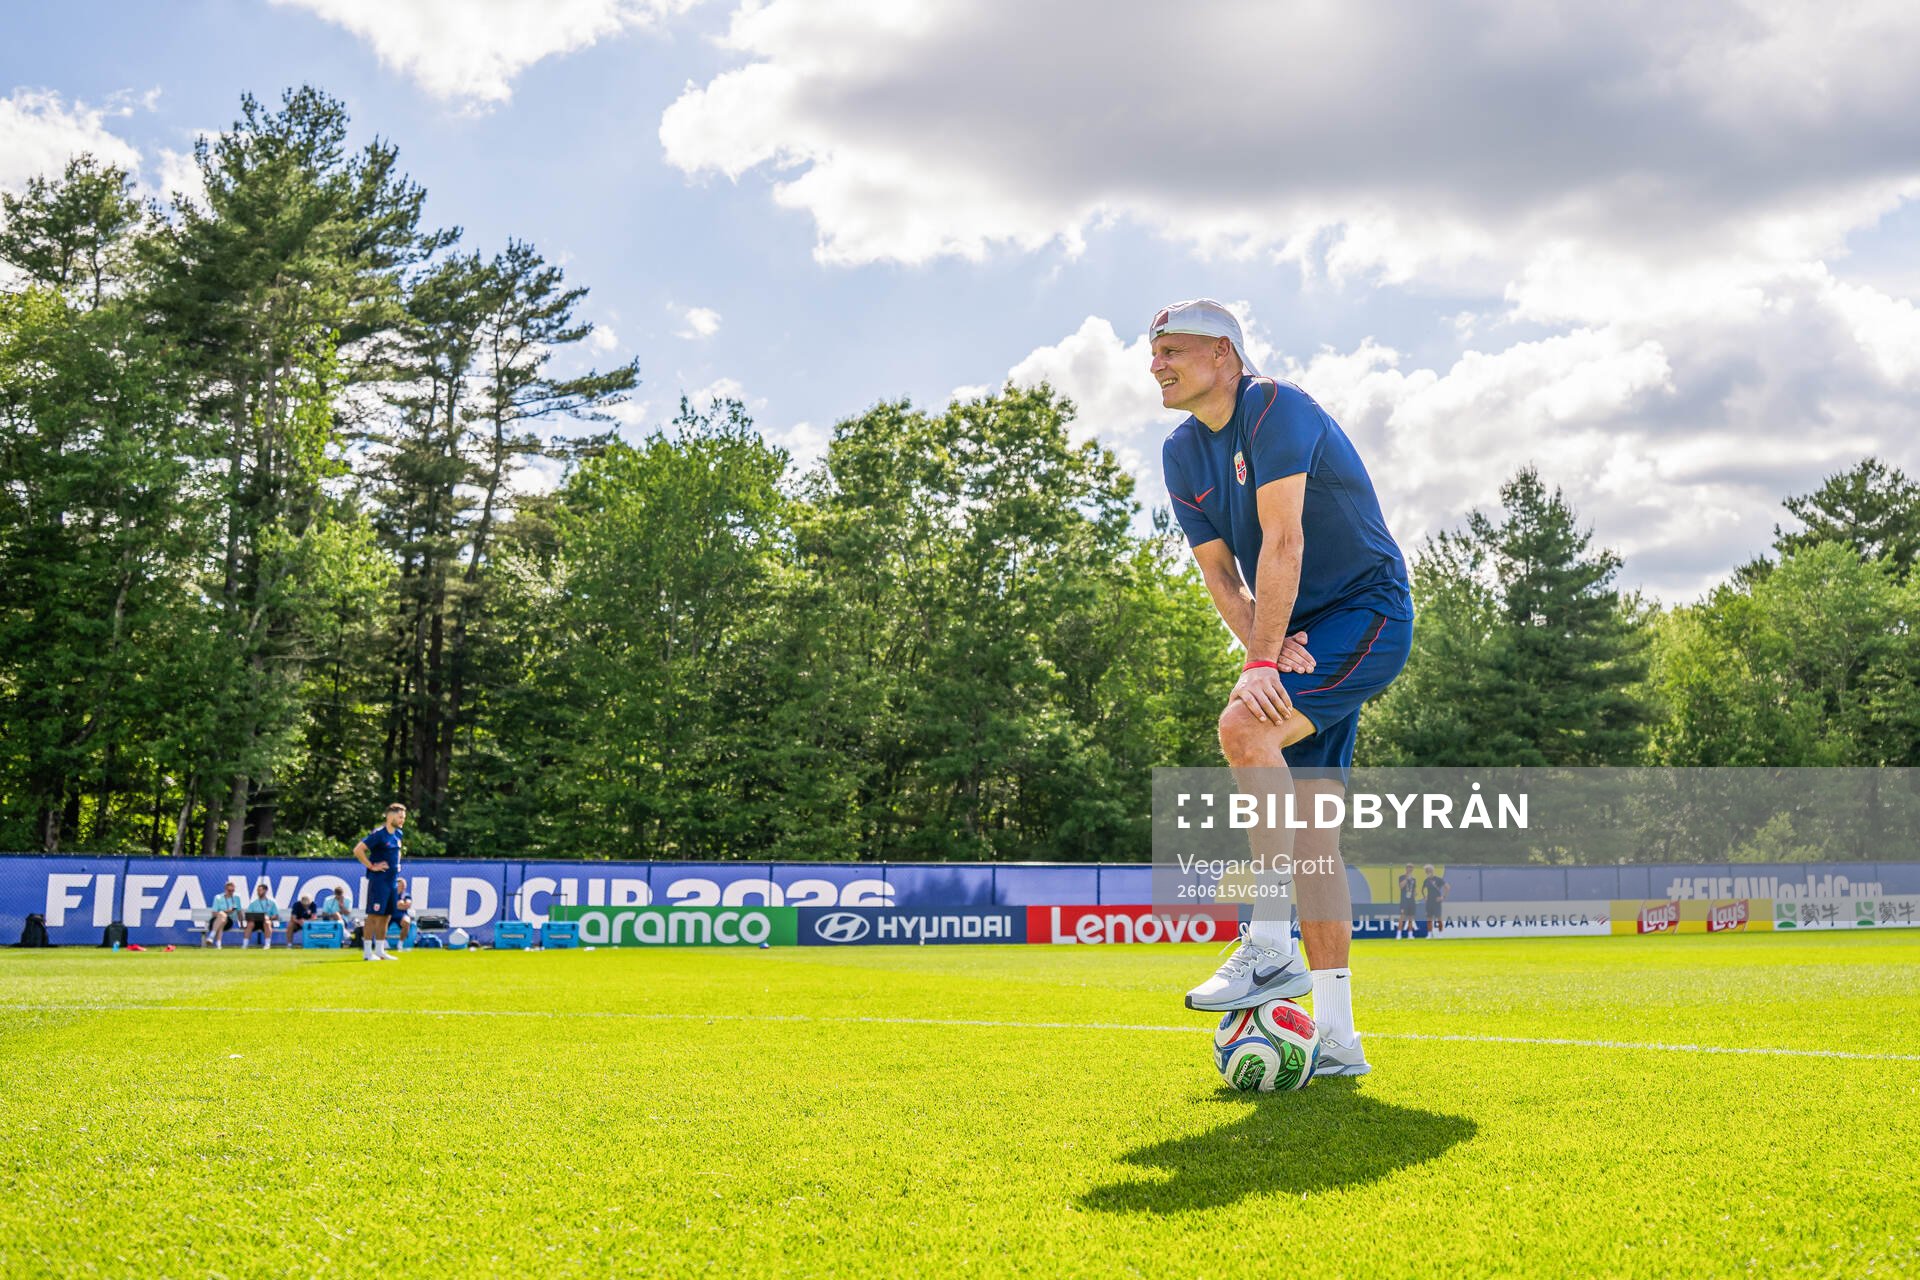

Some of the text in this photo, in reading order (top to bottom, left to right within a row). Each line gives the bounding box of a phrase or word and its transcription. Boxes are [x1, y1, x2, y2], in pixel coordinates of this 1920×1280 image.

[45, 873, 208, 928] FIFA
[1801, 903, 1840, 927] 蒙牛
[1879, 901, 1916, 925] 蒙牛
[578, 911, 771, 944] aramco
[878, 915, 1011, 939] HYUNDAI
[1051, 907, 1216, 944] Lenovo
[1486, 915, 1507, 928] OF
[1512, 914, 1589, 927] AMERICA
[1642, 903, 1676, 933] Lay's
[1712, 901, 1746, 932] Lay's
